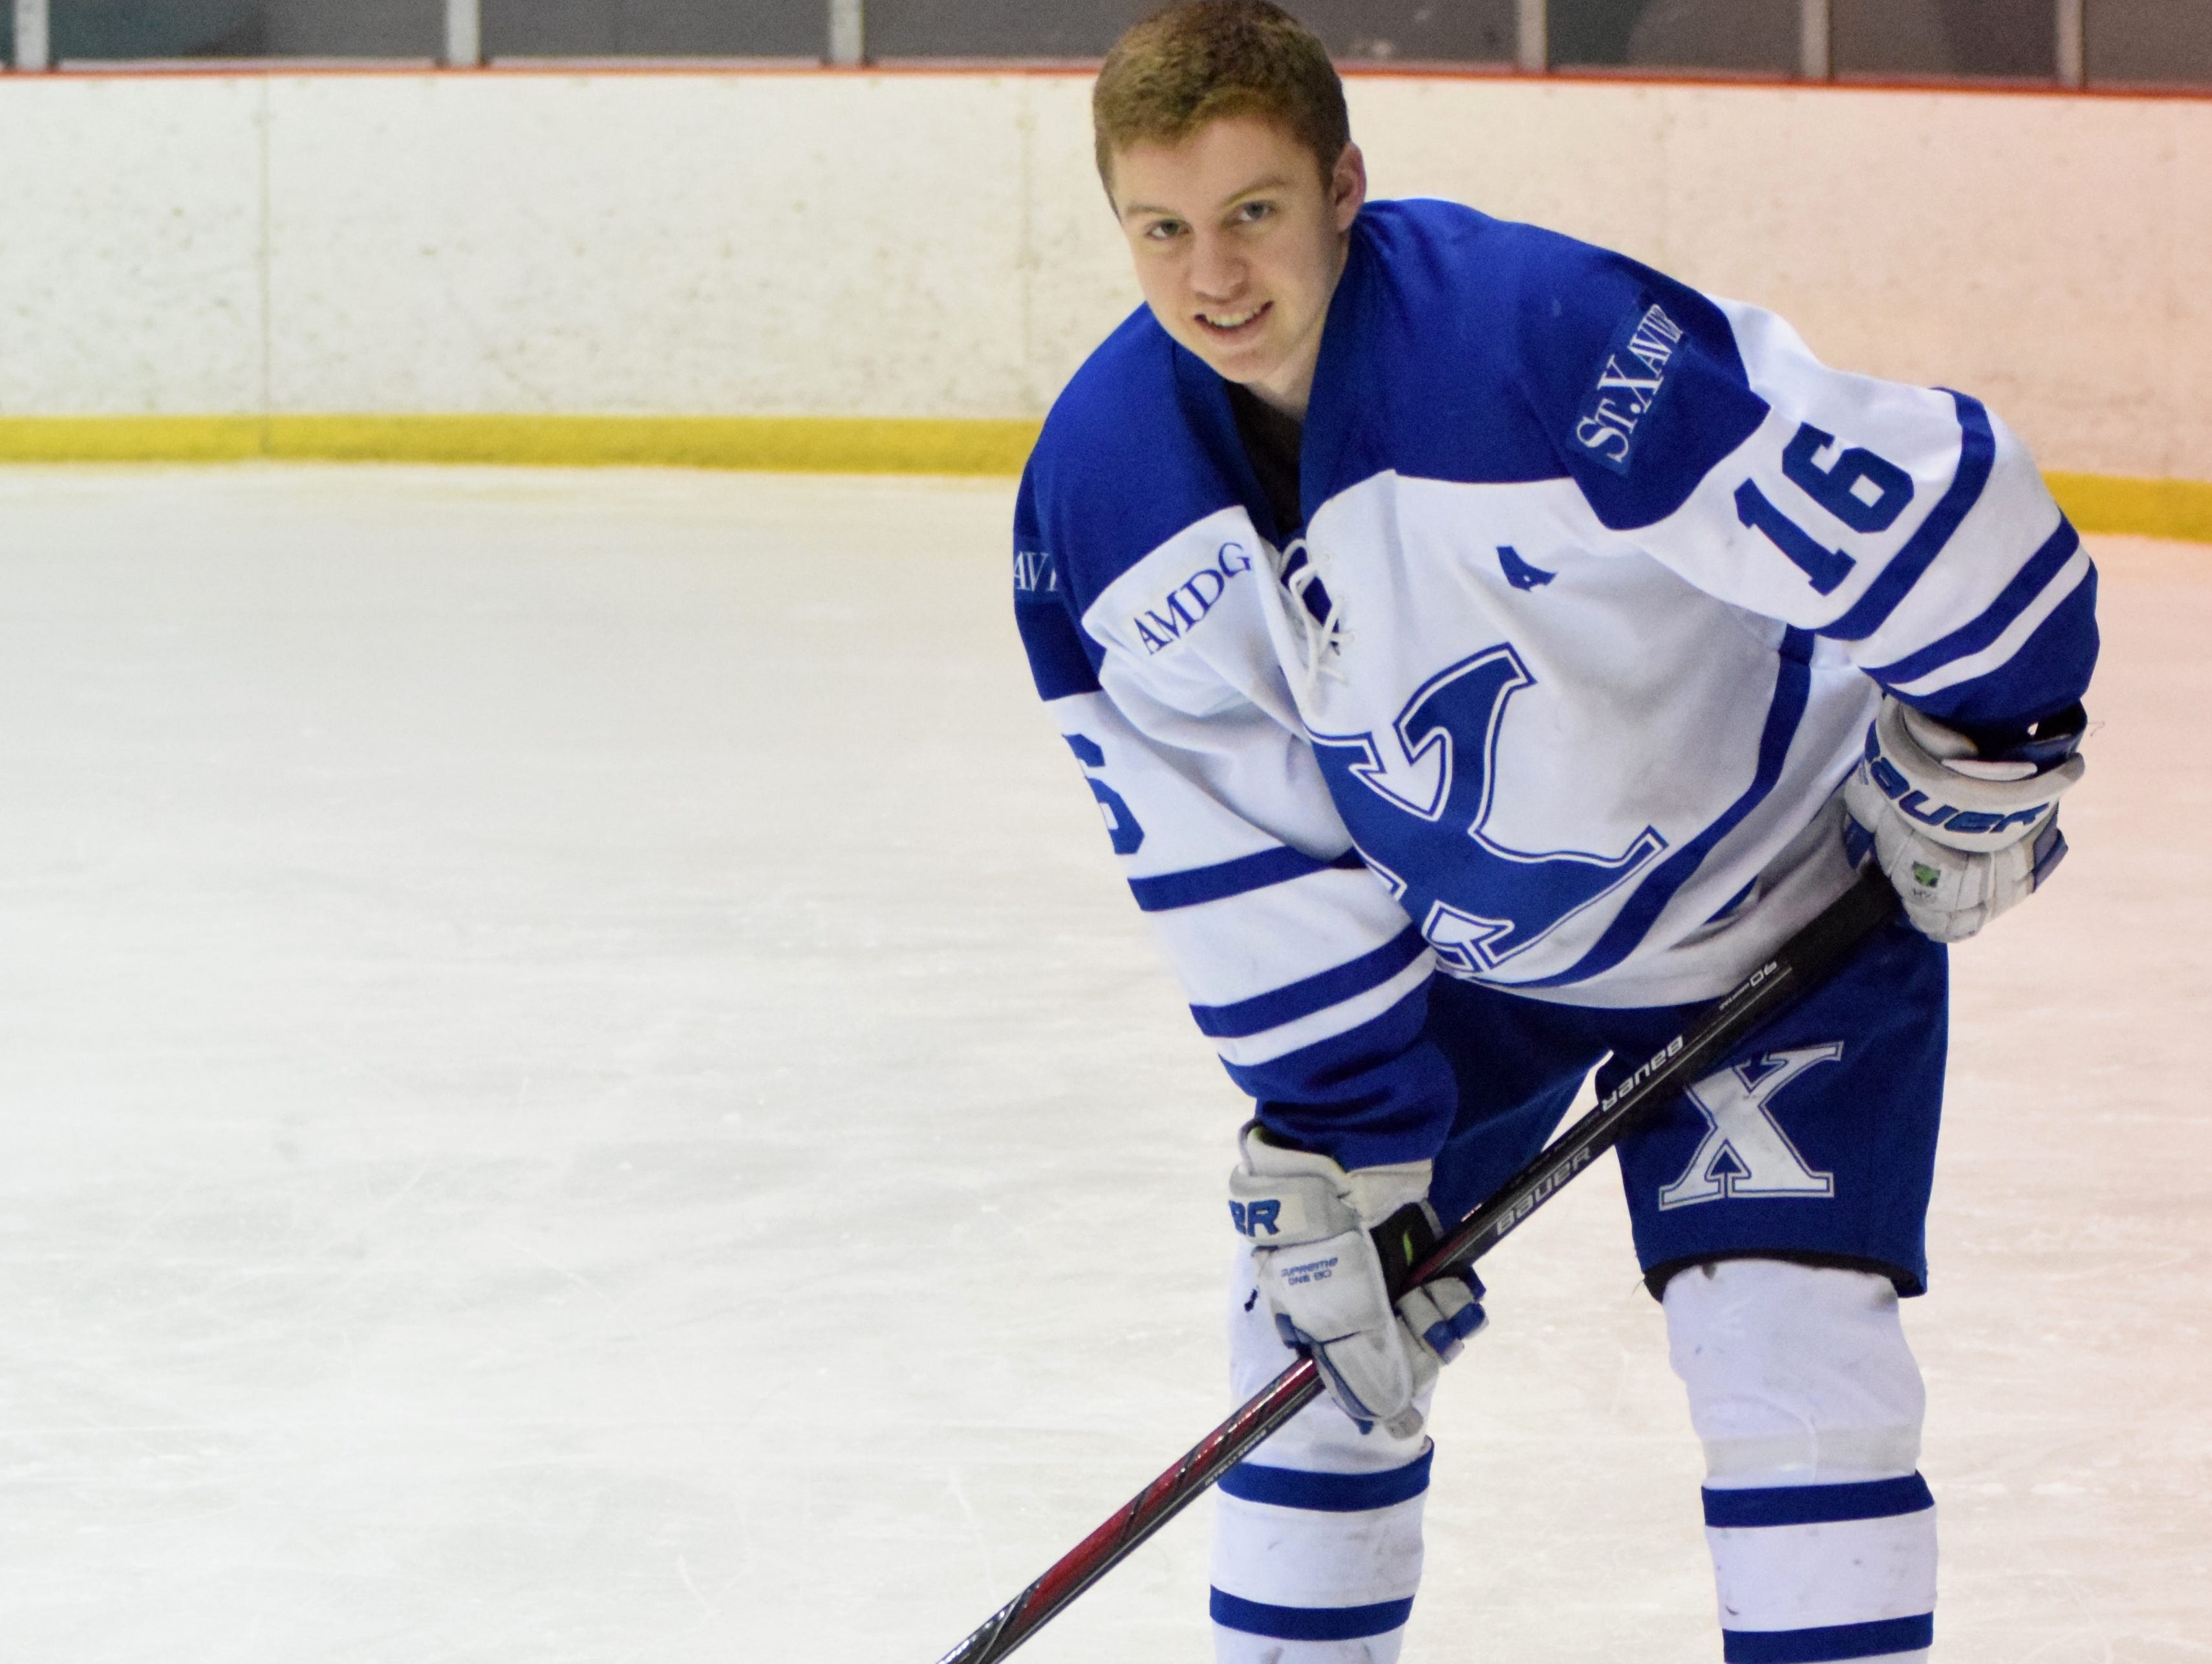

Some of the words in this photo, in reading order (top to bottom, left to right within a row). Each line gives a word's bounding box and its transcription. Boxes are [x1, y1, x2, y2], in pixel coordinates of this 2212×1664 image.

[1734, 422, 1914, 596] 16
[1133, 542, 1252, 654] AMDG
[1602, 1035, 1683, 1112] BAUER
[1659, 1041, 1845, 1211] X
[1497, 1147, 1591, 1236] BAUER
